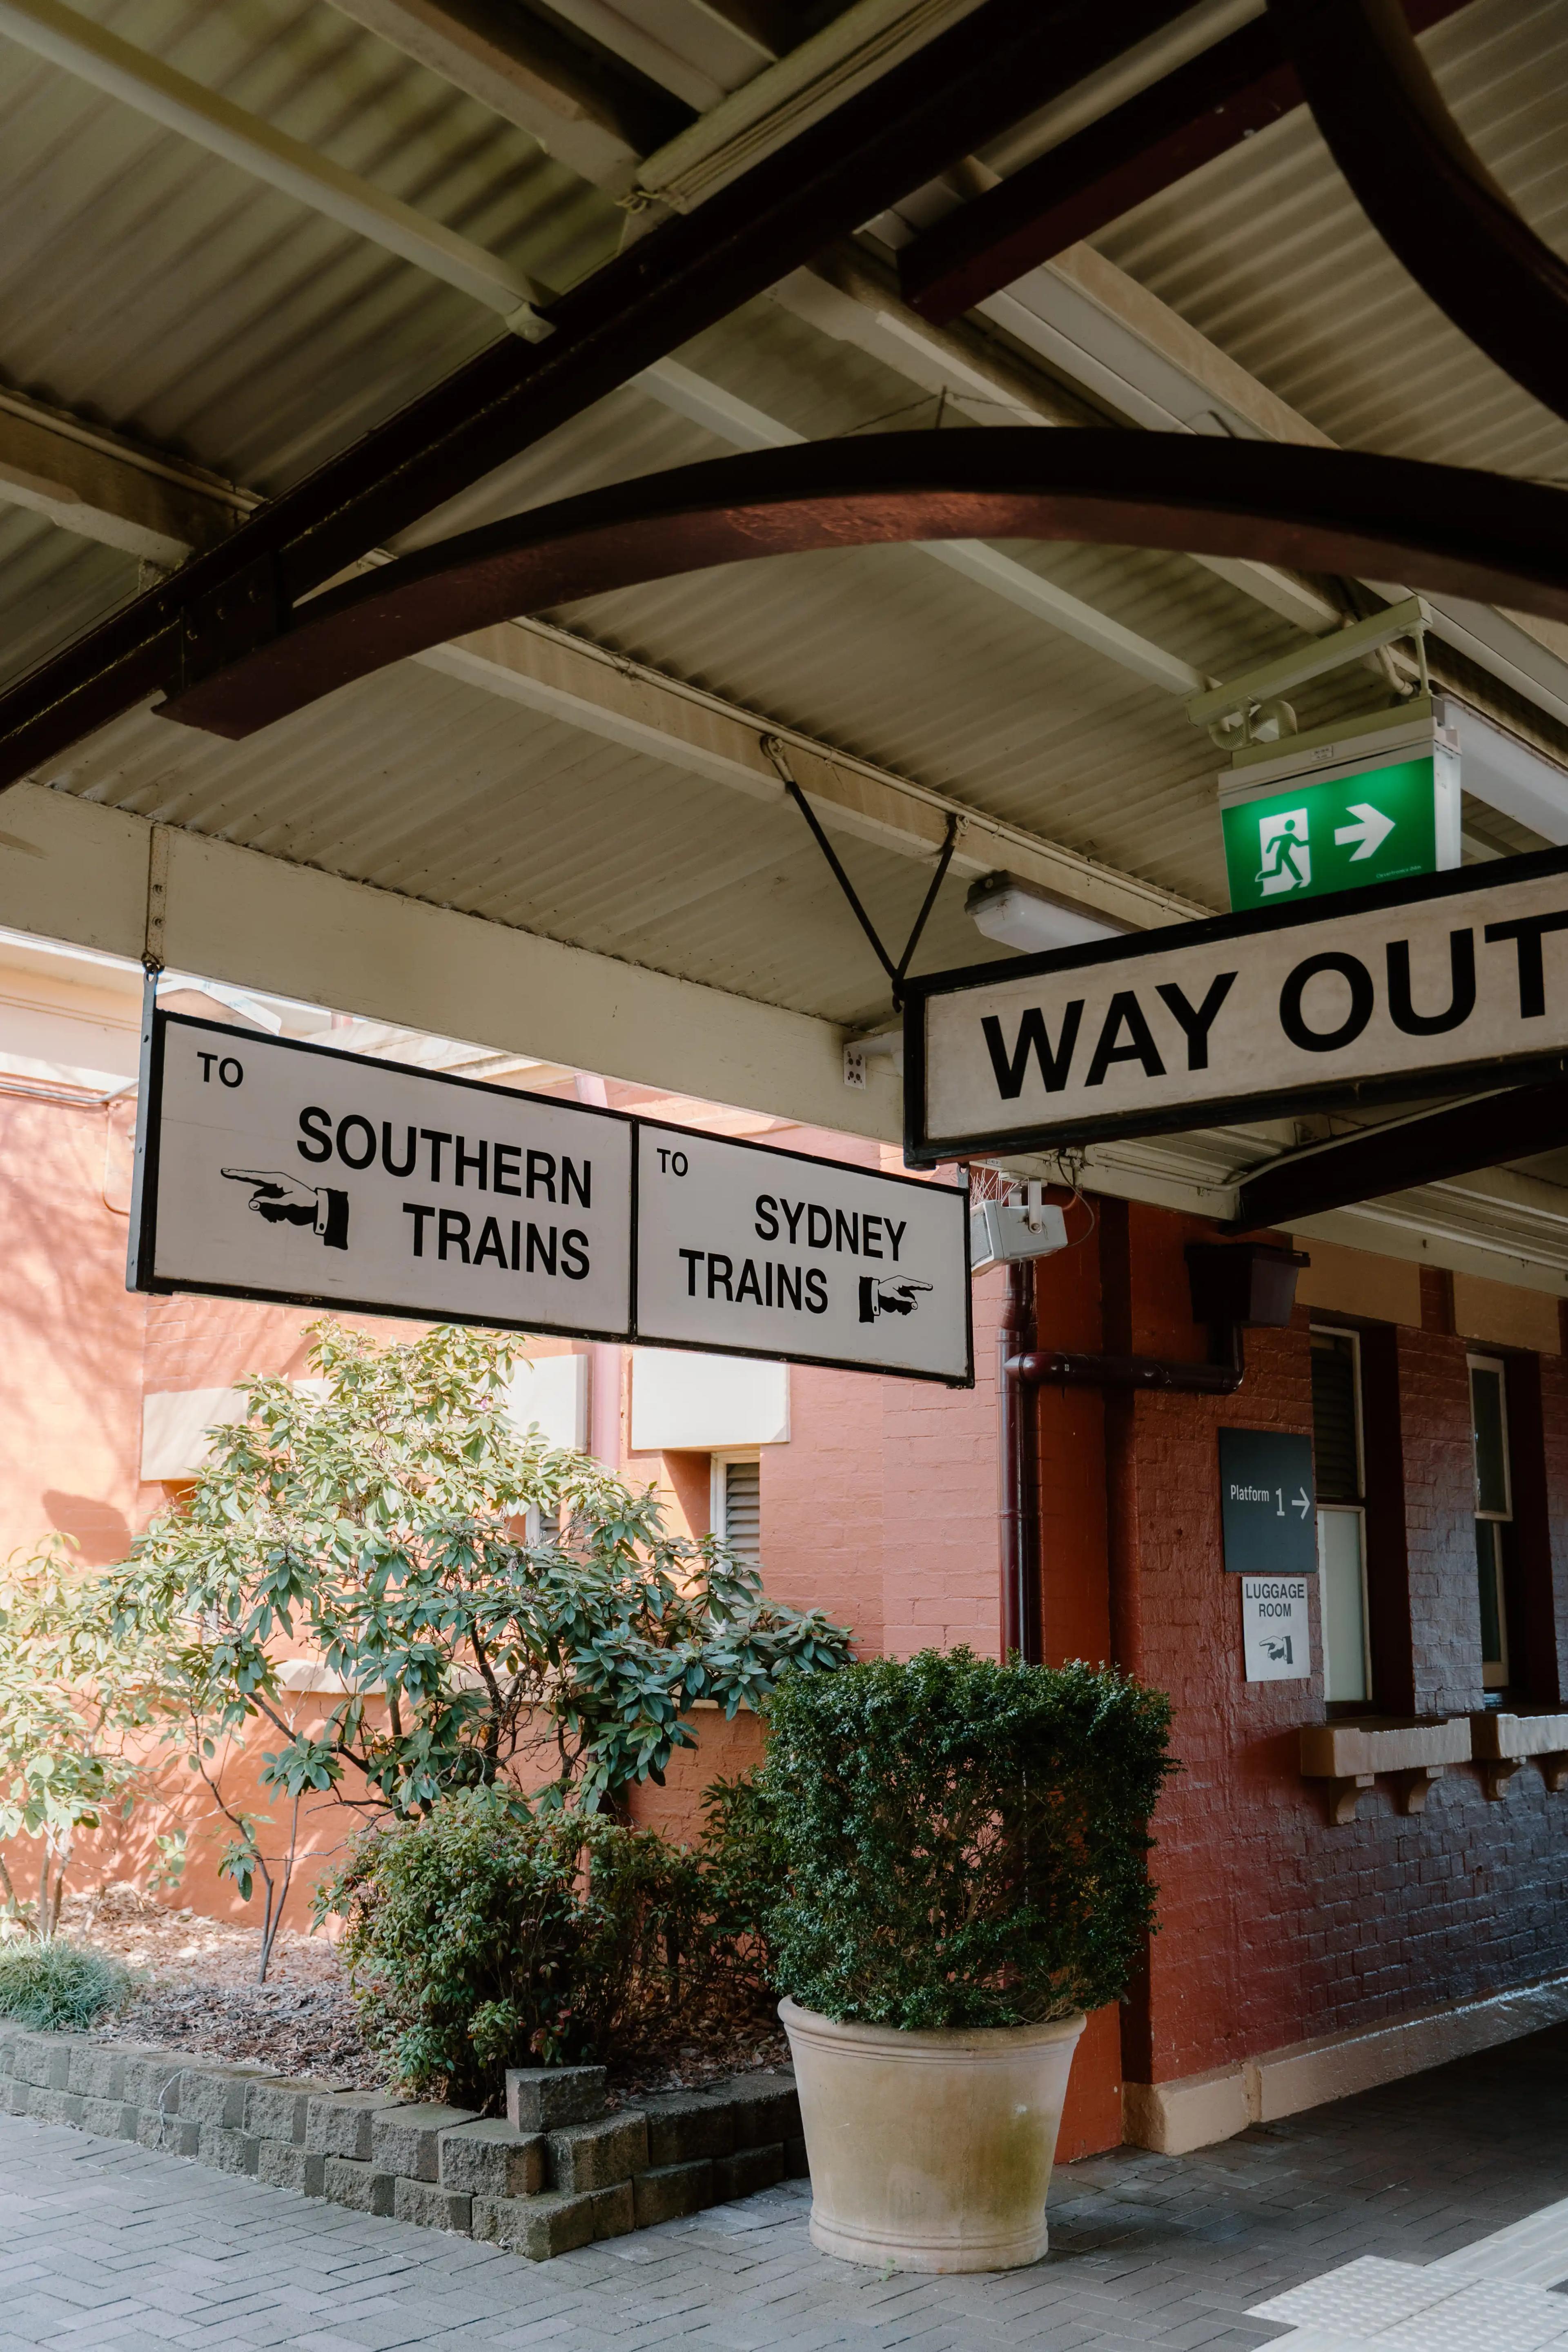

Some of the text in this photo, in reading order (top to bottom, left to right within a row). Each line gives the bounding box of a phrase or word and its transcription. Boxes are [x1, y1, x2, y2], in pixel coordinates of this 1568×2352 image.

[981, 910, 1568, 1100] WAY OUT
[197, 1051, 243, 1088] TO
[297, 1106, 592, 1209] SOUTHERN
[657, 1148, 688, 1177] TO
[403, 1203, 590, 1281] TRAINS
[755, 1194, 906, 1261] SYDNEY
[679, 1248, 828, 1314] TRAINS
[1230, 1484, 1285, 1516] Platform 1
[1246, 1583, 1305, 1599] LUGGAGE
[1259, 1603, 1291, 1617] ROOM
